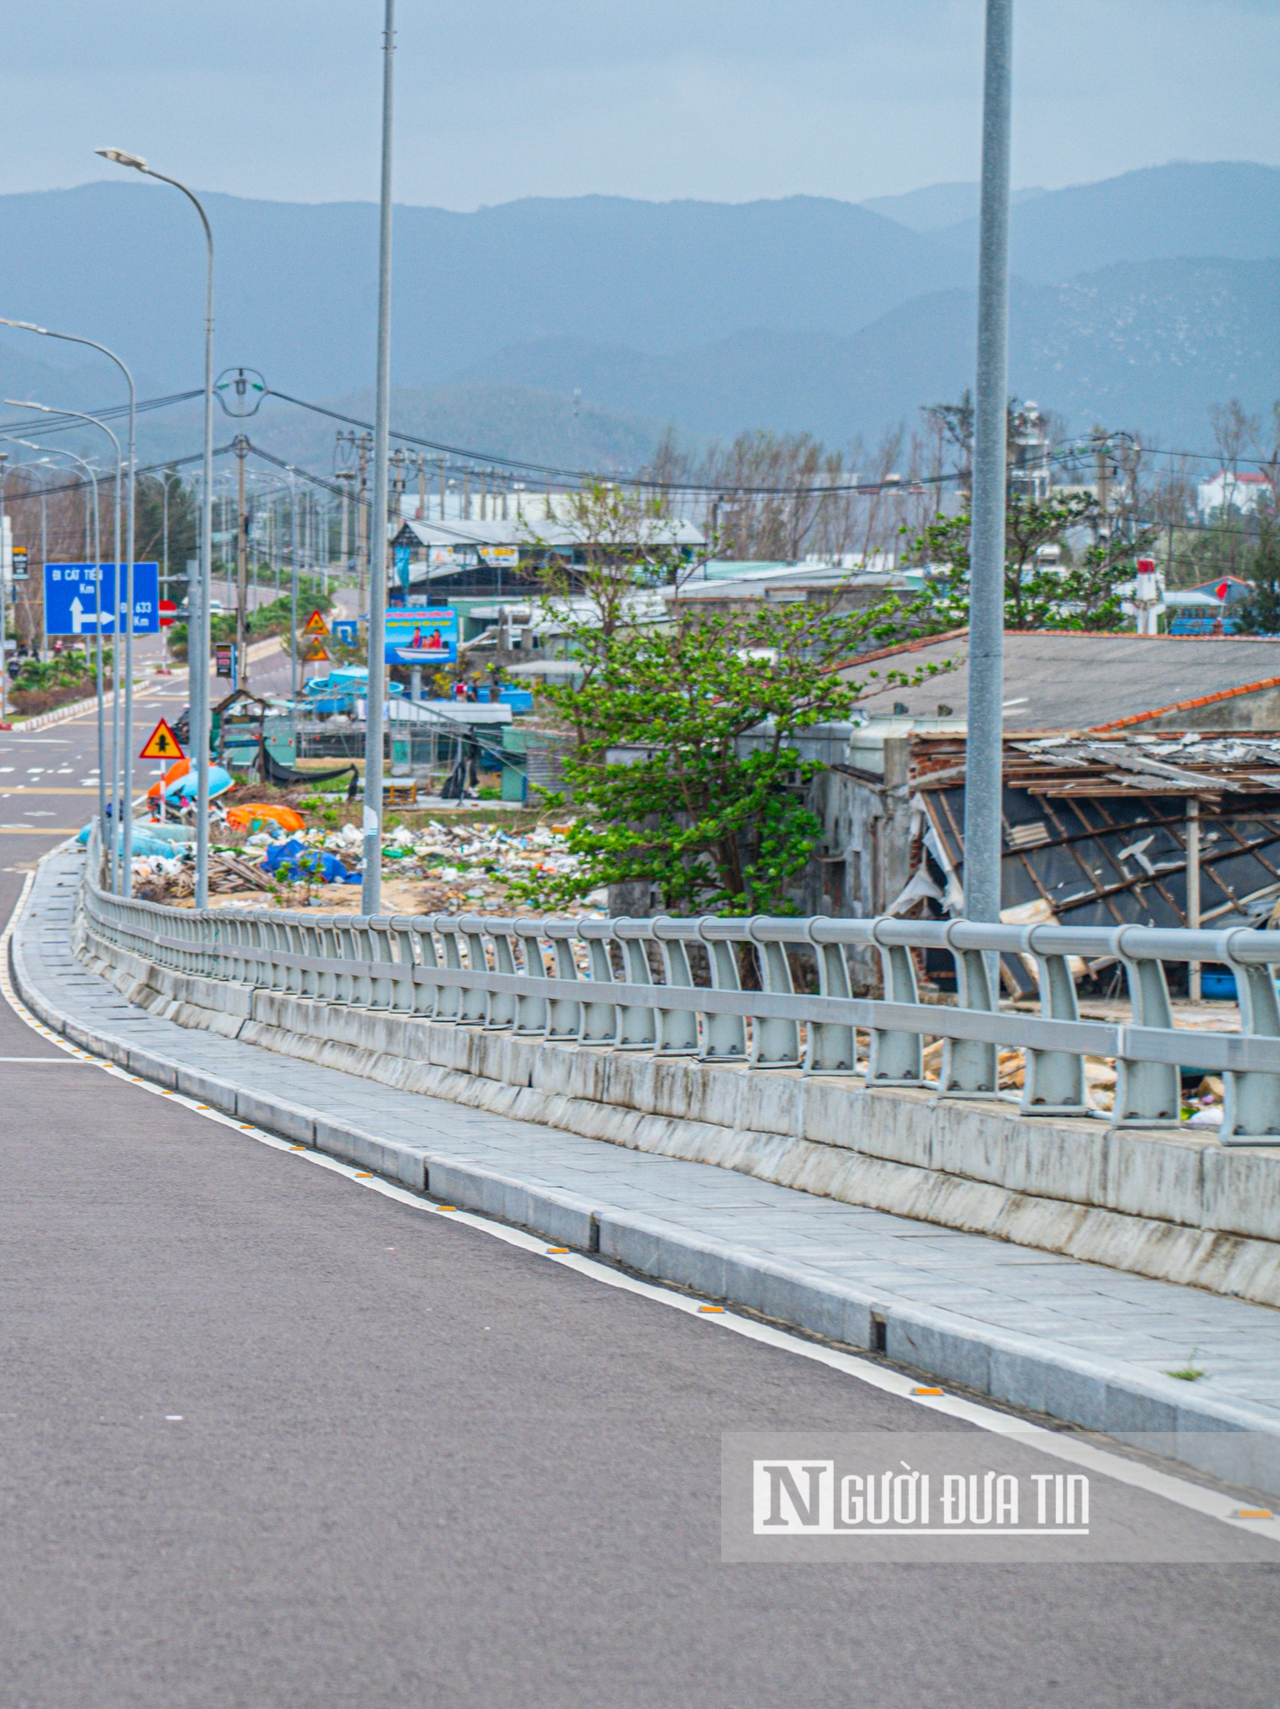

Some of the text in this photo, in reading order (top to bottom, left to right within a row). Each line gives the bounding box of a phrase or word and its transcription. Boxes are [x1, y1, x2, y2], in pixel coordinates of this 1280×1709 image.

[65, 566, 80, 581] CÁT
[80, 583, 95, 594] Km
[135, 602, 152, 613] 633
[133, 616, 149, 626] Km
